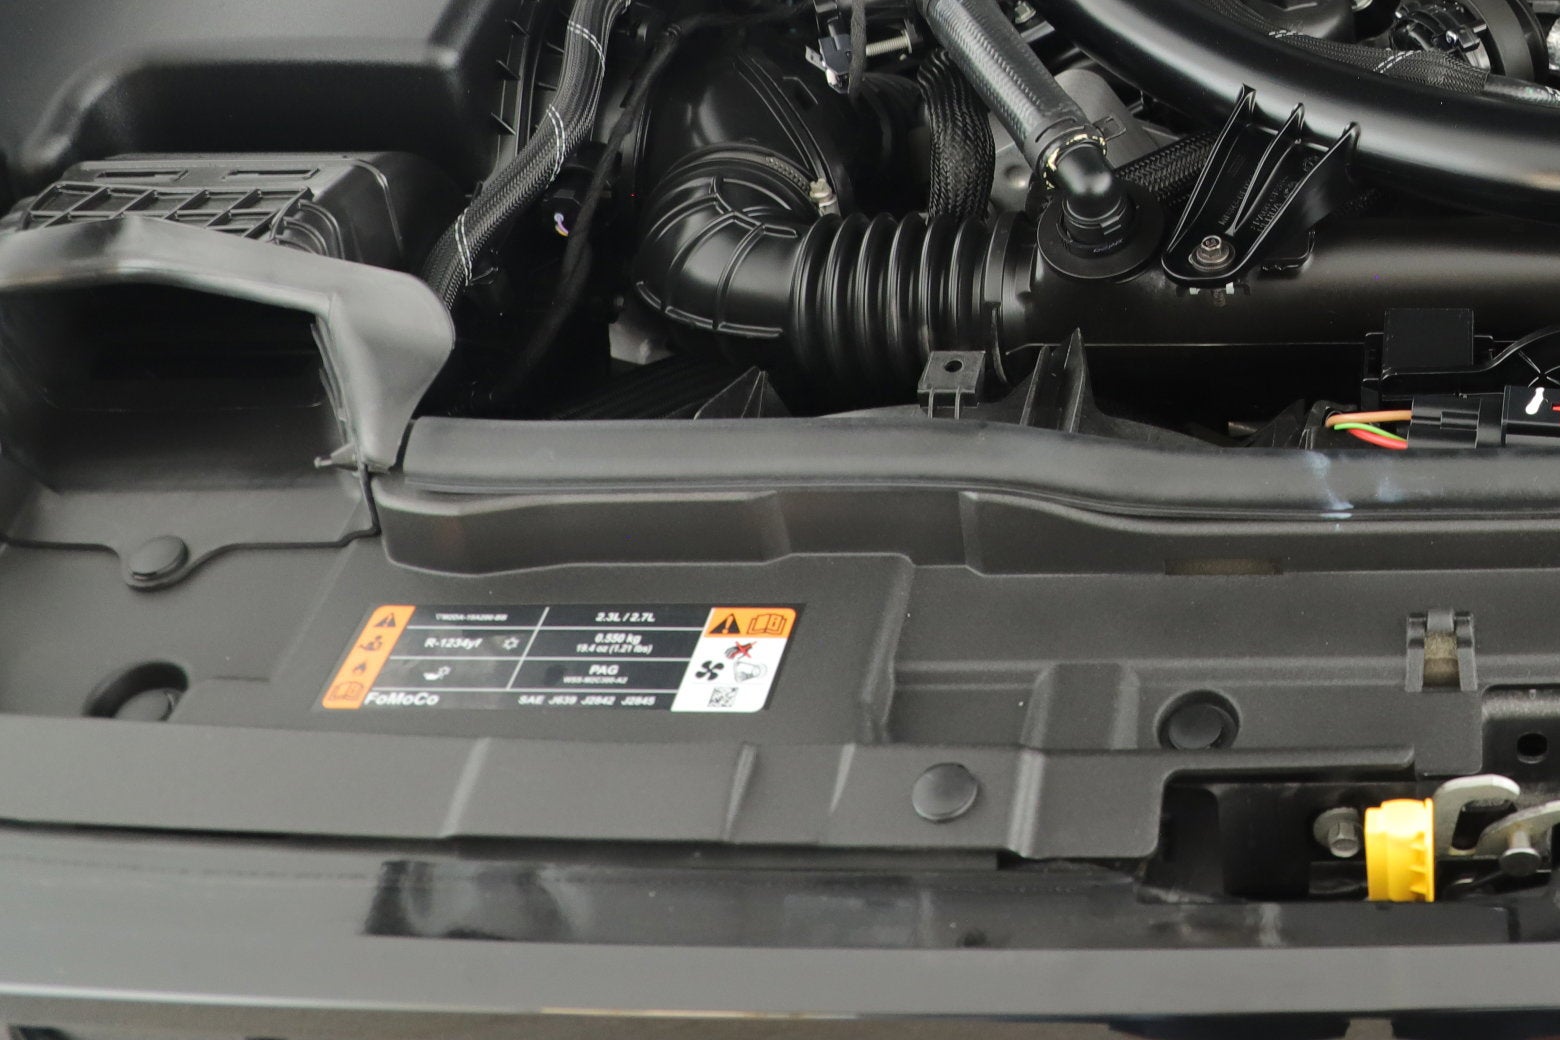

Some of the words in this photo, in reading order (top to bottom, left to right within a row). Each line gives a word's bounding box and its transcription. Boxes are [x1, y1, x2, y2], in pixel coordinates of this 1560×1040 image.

[595, 612, 621, 622] 2.3L
[630, 612, 656, 622] 2.7L
[424, 637, 482, 650] R-1234yf
[594, 633, 624, 643] 0.550
[625, 633, 642, 645] kg
[588, 664, 619, 675] PAG
[364, 692, 440, 706] FoMoCo
[518, 695, 545, 705] SAE
[548, 695, 578, 706] J639
[580, 695, 616, 706] J2842
